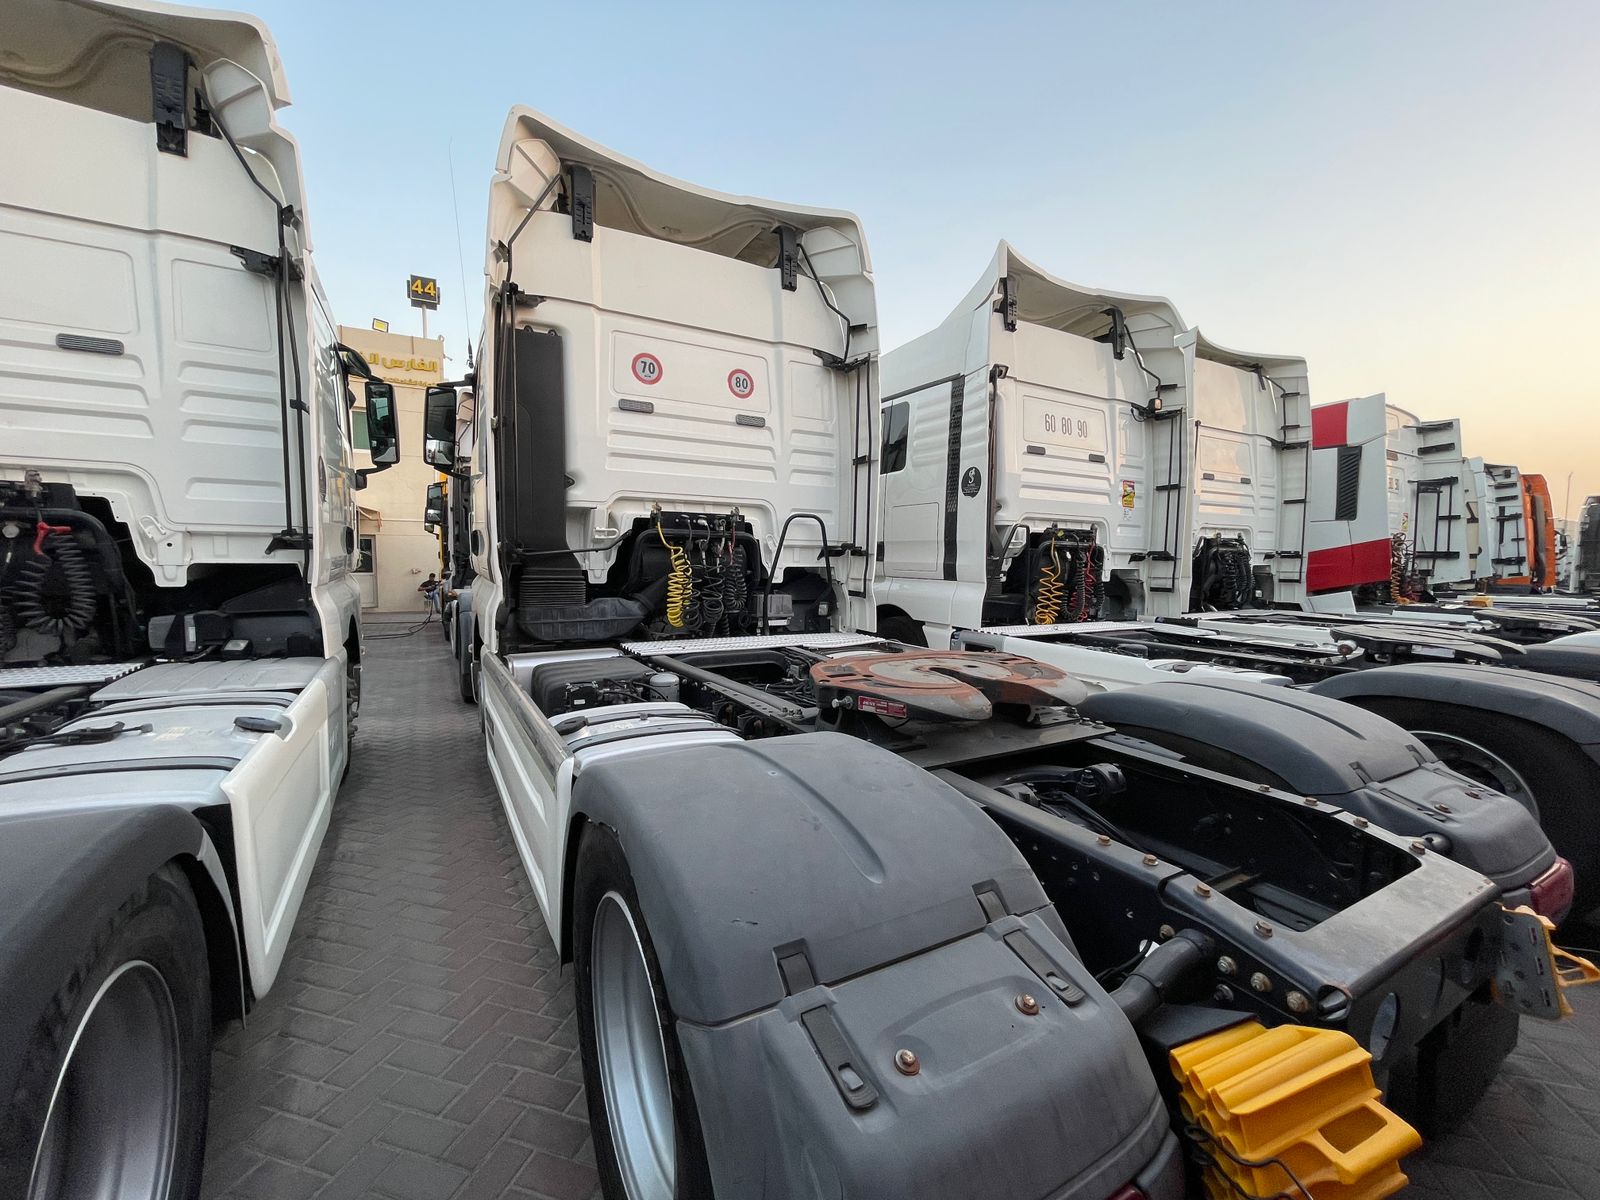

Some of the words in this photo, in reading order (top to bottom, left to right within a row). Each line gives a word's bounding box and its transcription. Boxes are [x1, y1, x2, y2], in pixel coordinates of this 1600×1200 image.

[411, 279, 436, 296] 44
[382, 357, 437, 373] الفارس
[640, 360, 656, 374] 70
[735, 376, 748, 389] 80
[1044, 413, 1056, 433] 60
[1061, 416, 1072, 436] 80
[1077, 419, 1088, 438] 90
